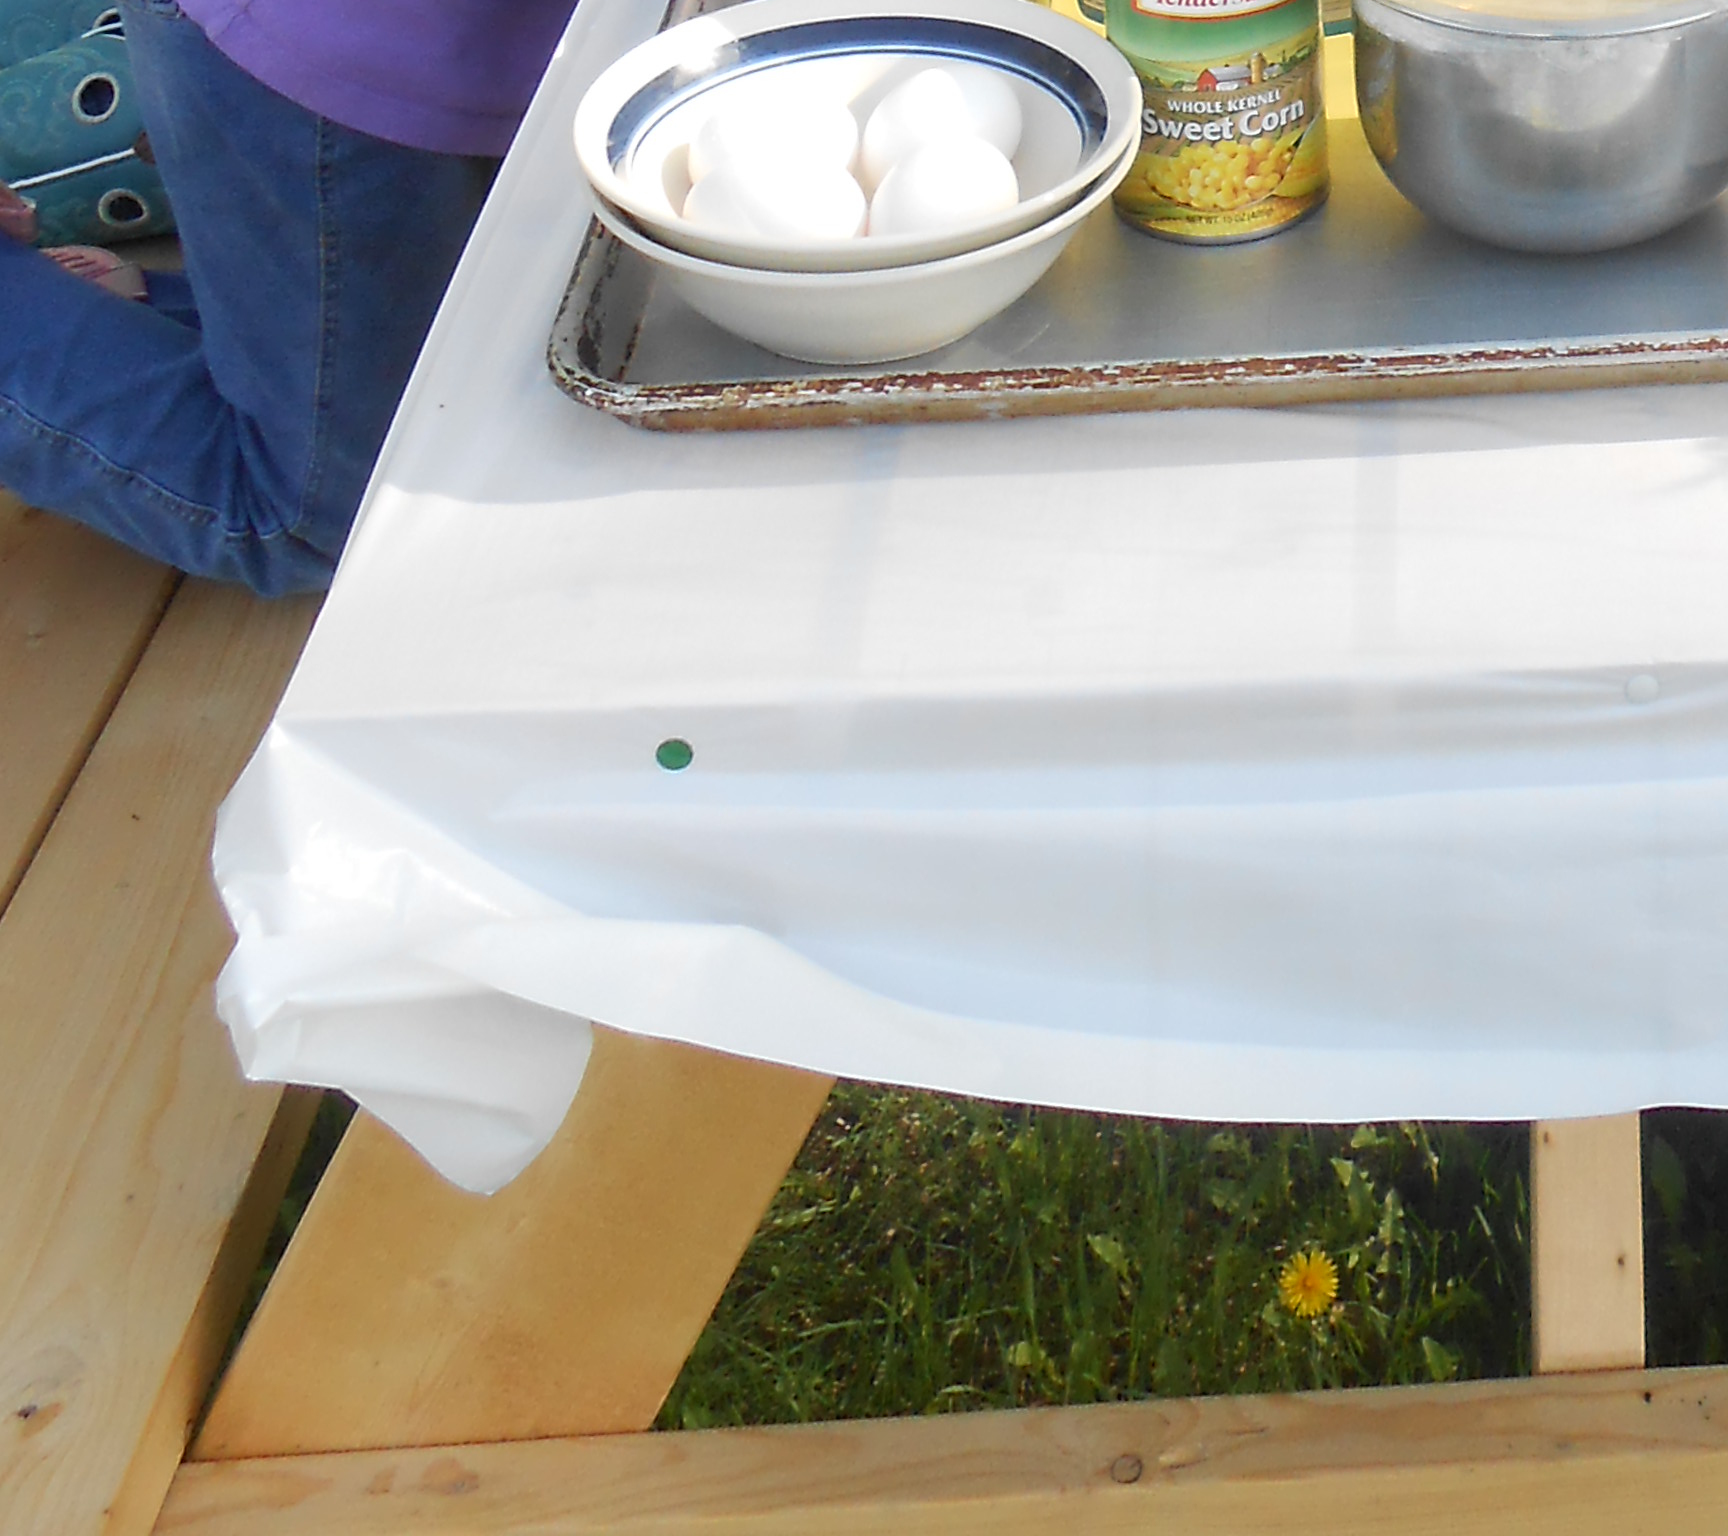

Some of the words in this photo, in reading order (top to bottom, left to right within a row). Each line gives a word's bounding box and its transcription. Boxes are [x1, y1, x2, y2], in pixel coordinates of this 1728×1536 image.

[1167, 100, 1224, 114] WHOLE
[1227, 89, 1281, 112] KERNEL
[1142, 109, 1234, 141] Sweet
[1238, 99, 1305, 136] Corn
